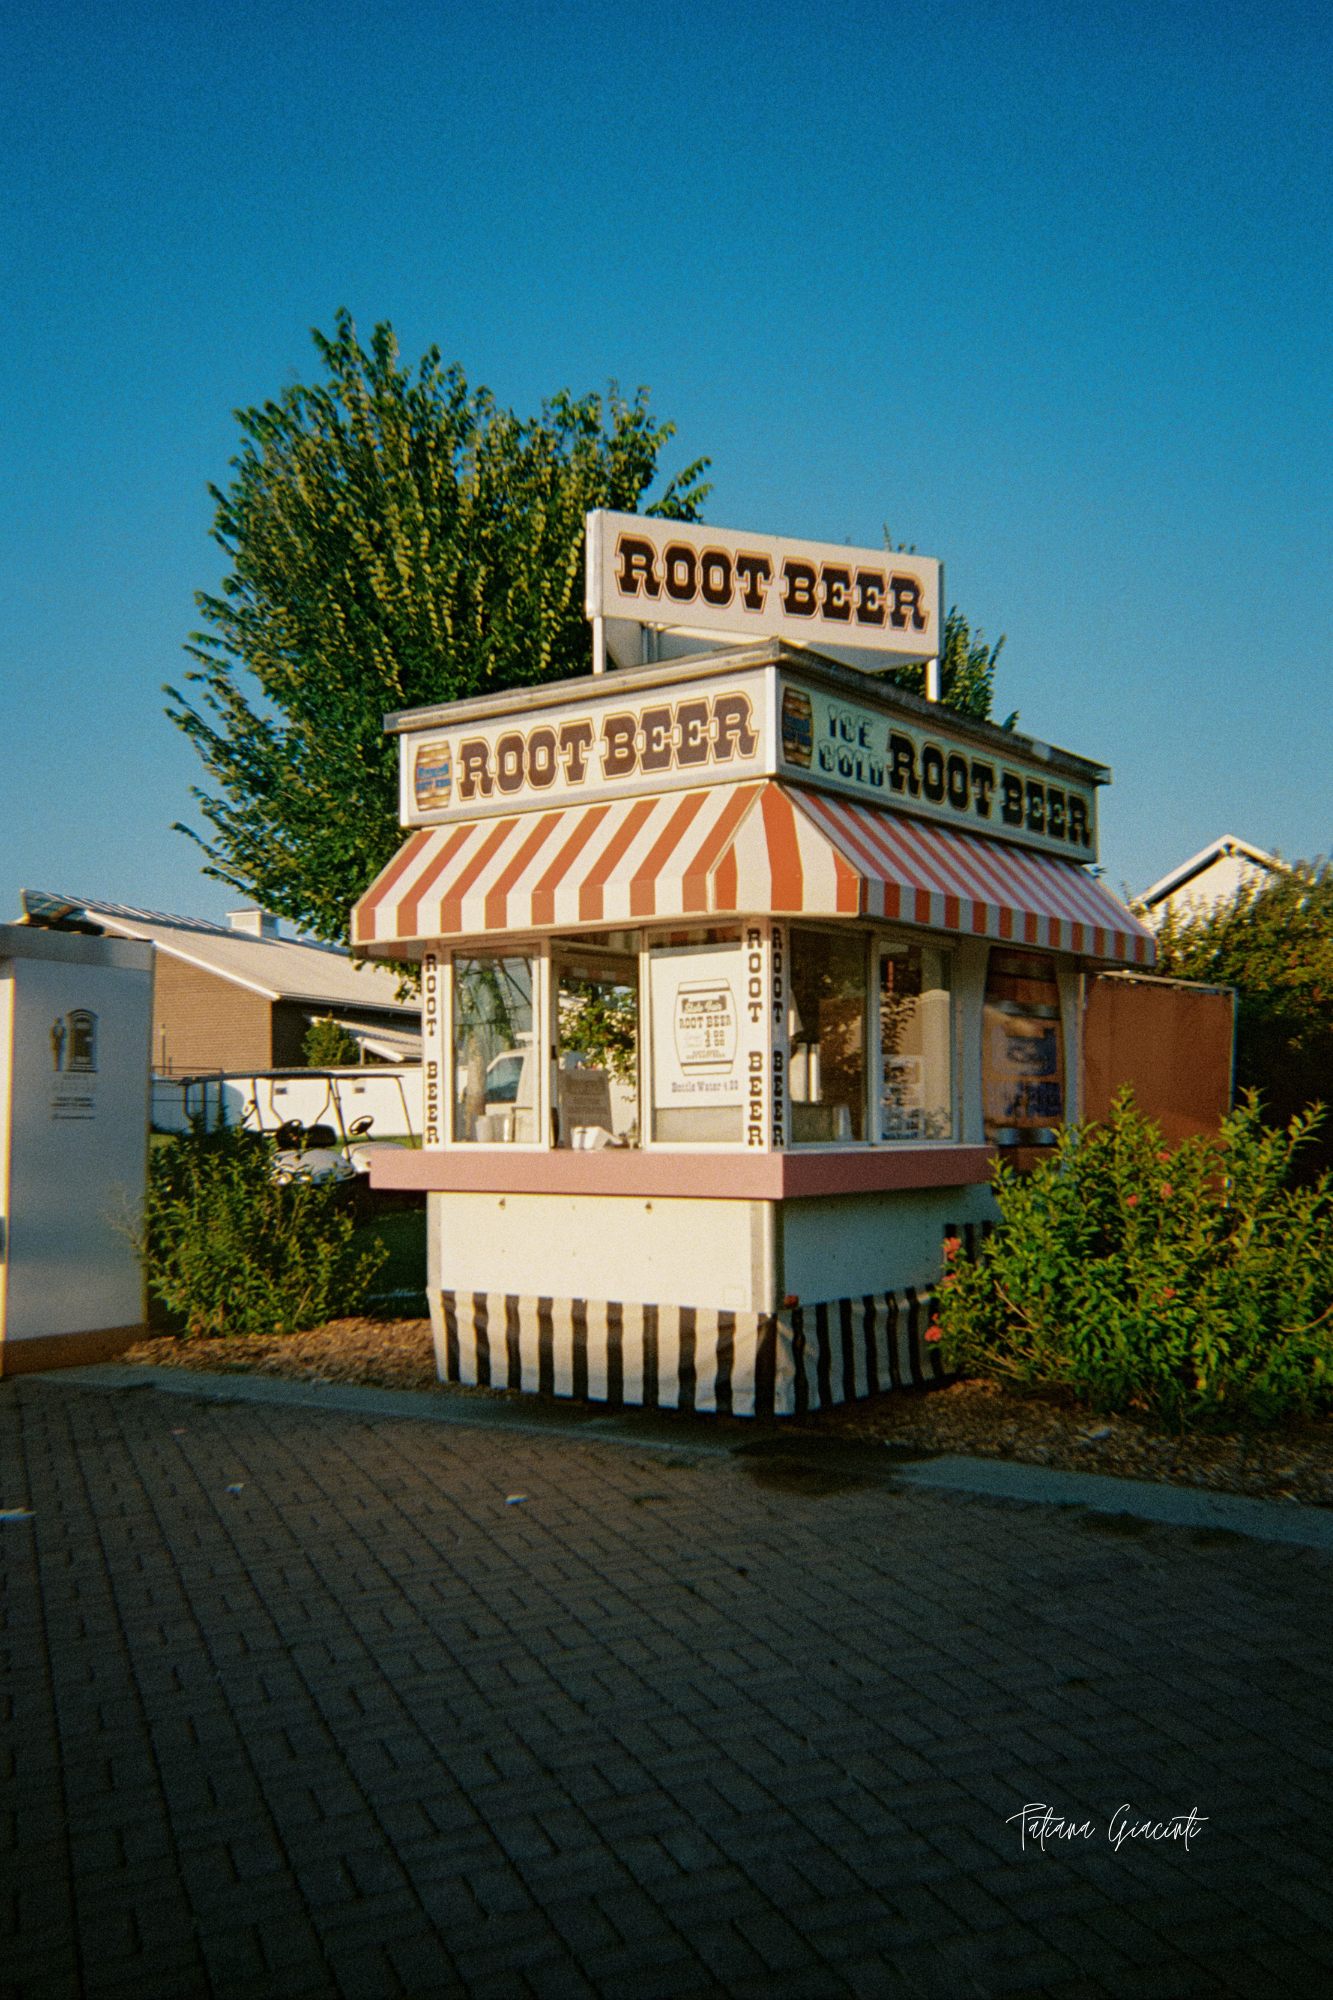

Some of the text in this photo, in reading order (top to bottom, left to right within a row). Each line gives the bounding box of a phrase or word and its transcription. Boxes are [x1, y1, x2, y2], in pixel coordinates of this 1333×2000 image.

[615, 531, 930, 633] ROOT BEER
[457, 690, 760, 801] ROOT BEER
[818, 738, 885, 787] COLD
[827, 703, 873, 750] ICE
[886, 727, 1095, 849] ROOT BEER
[425, 952, 440, 1145] ROOT BEER
[679, 1015, 731, 1029] ROOT BEER
[747, 927, 764, 1147] ROOT BEER
[771, 926, 785, 1147] ROOT BEER
